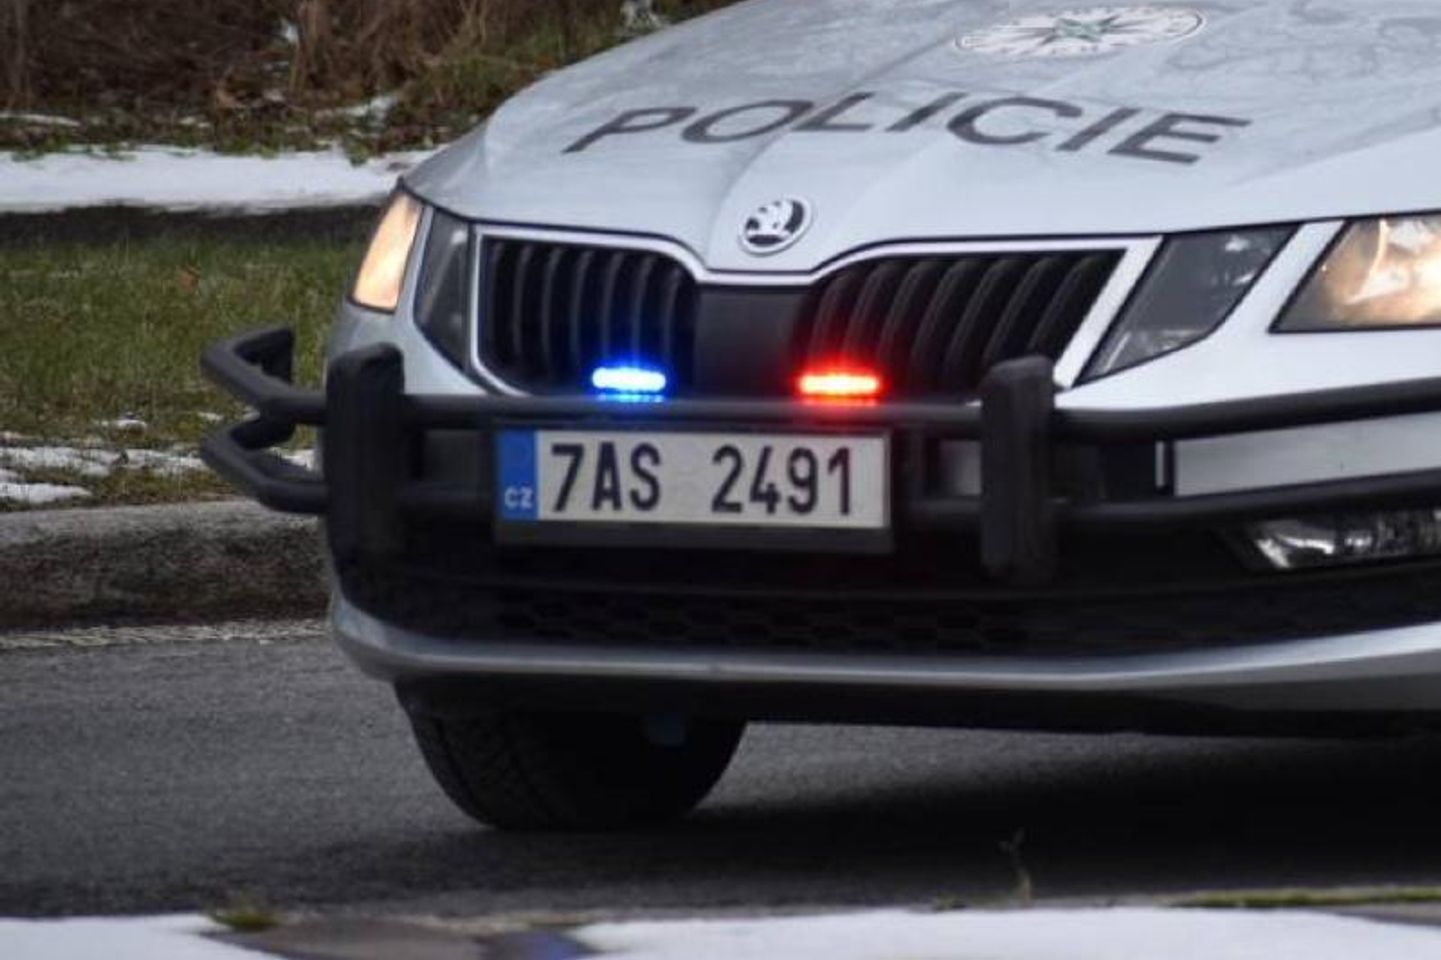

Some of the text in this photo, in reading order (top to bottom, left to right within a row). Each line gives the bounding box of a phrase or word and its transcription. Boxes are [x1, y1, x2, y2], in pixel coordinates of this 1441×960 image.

[561, 91, 1251, 165] POLICIE
[503, 486, 534, 510] CZ
[551, 441, 852, 516] 7AS 2491
